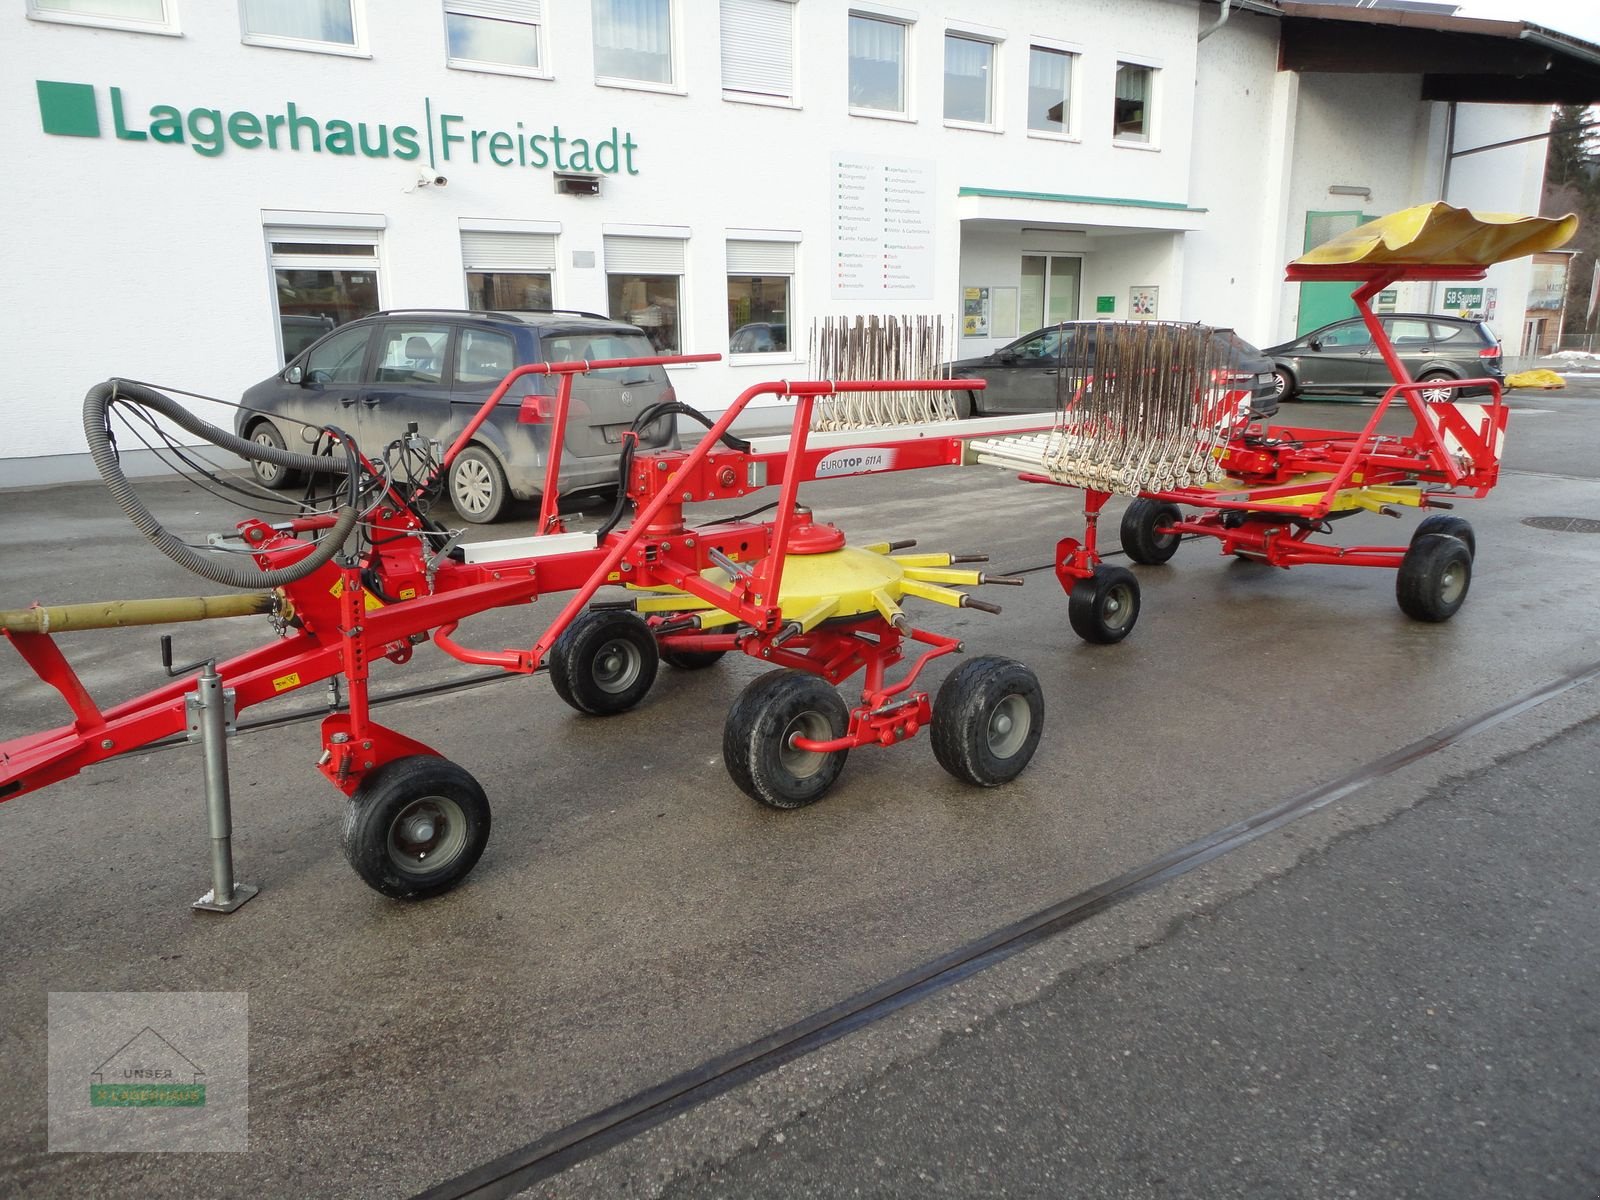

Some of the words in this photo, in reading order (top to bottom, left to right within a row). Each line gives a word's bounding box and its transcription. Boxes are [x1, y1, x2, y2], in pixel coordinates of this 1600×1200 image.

[109, 86, 420, 160] Lagerhaus
[440, 113, 640, 176] Freistadt
[1446, 291, 1457, 304] SB
[1457, 292, 1481, 306] Saugen
[821, 457, 863, 471] EUROTOP
[865, 455, 882, 466] 611A
